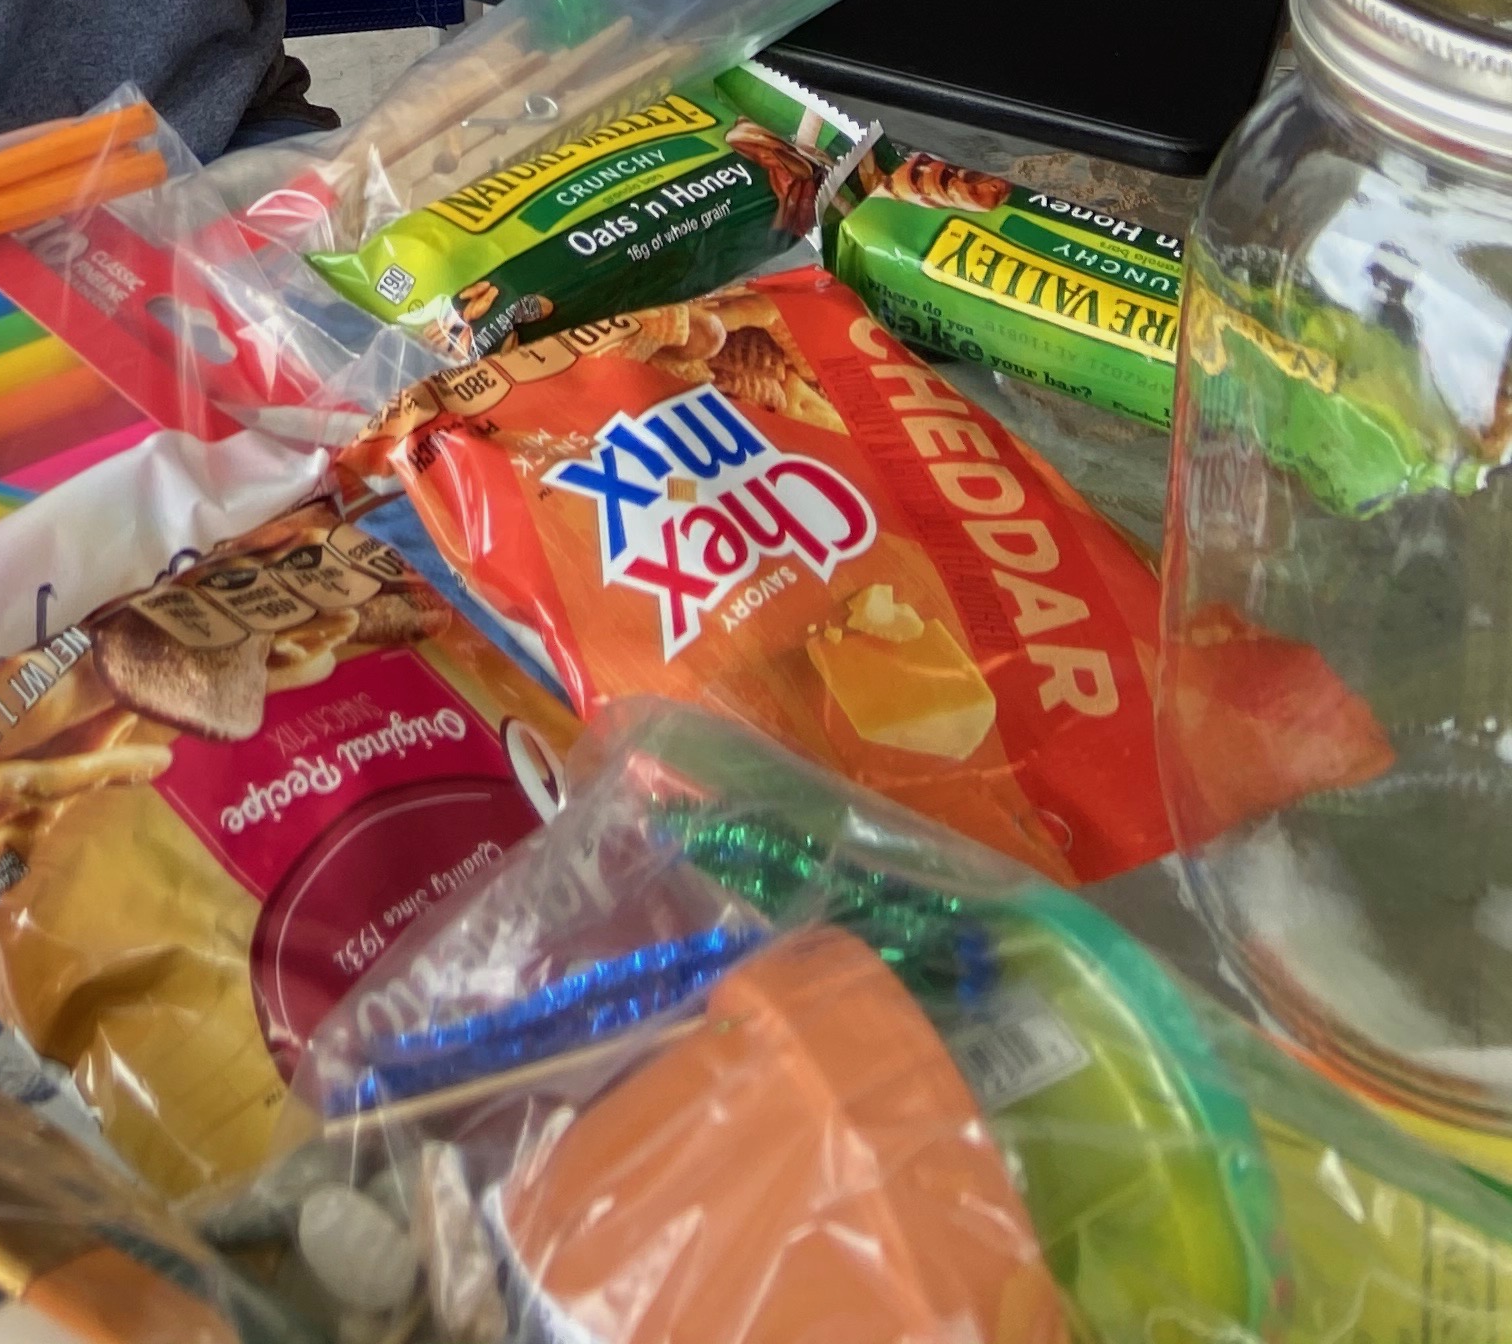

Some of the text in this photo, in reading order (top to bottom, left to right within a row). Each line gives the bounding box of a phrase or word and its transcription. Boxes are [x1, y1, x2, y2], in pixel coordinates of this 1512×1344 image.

[448, 97, 694, 224] NATURE VALLEY
[556, 148, 667, 207] CRUNCHY
[567, 161, 754, 257] Oats 'n Honey
[651, 234, 665, 251] of
[664, 218, 700, 246] whole
[88, 249, 148, 295] CLASSIC
[378, 267, 407, 298] 190
[936, 229, 1106, 332] VALLEY
[1051, 242, 1183, 295] UNCHY
[1132, 252, 1182, 275] ranola
[920, 299, 943, 318] do
[946, 320, 975, 338] you
[880, 297, 1094, 401] take your bar?
[453, 368, 498, 403] 380
[847, 315, 1121, 718] CHEDDAR
[622, 459, 869, 642] Chex
[717, 565, 799, 635] SAVORY
[44, 623, 93, 676] NET
[7, 657, 50, 711] WT
[265, 691, 386, 757] SNACK MIX
[220, 707, 468, 835] Original Recipe
[428, 841, 507, 897] Quality
[382, 889, 435, 929] Since
